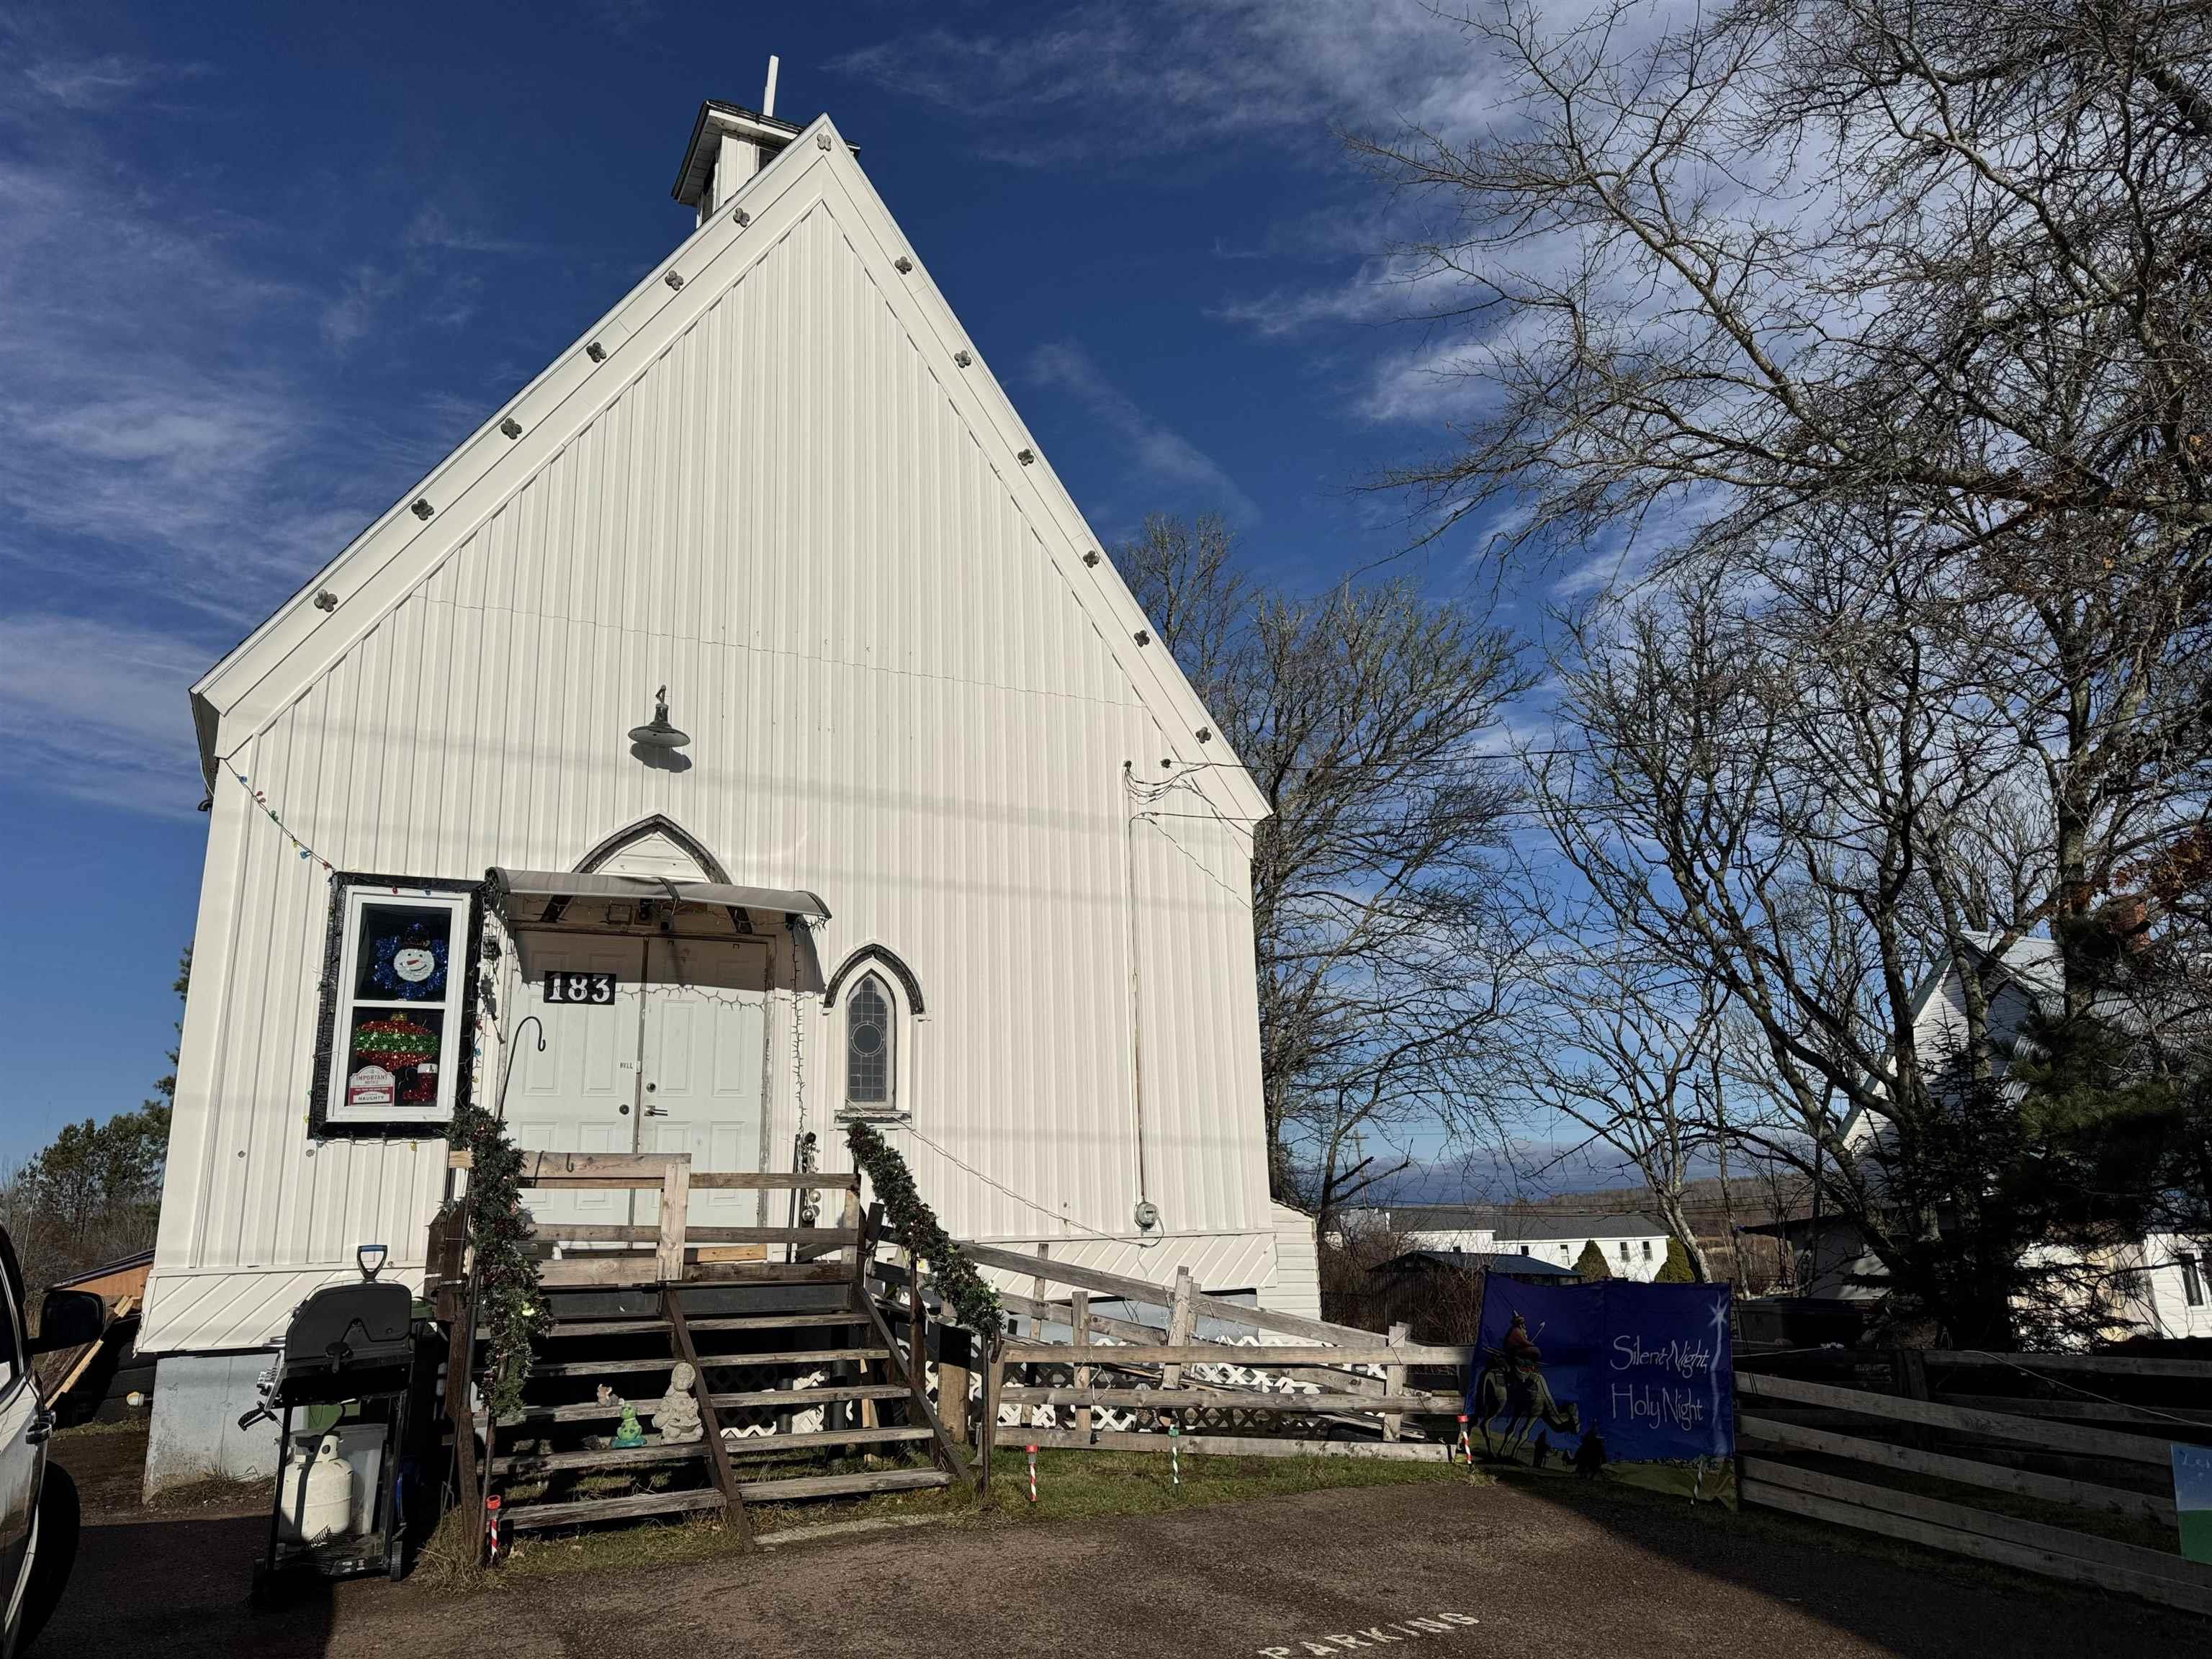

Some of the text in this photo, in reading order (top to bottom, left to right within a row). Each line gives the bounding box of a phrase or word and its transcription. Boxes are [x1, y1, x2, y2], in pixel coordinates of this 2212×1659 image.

[549, 972, 611, 1003] 183
[1609, 1335, 1668, 1370] Silent
[1611, 1382, 1704, 1431] Holy Night
[1256, 1612, 1480, 1659] PARKING
